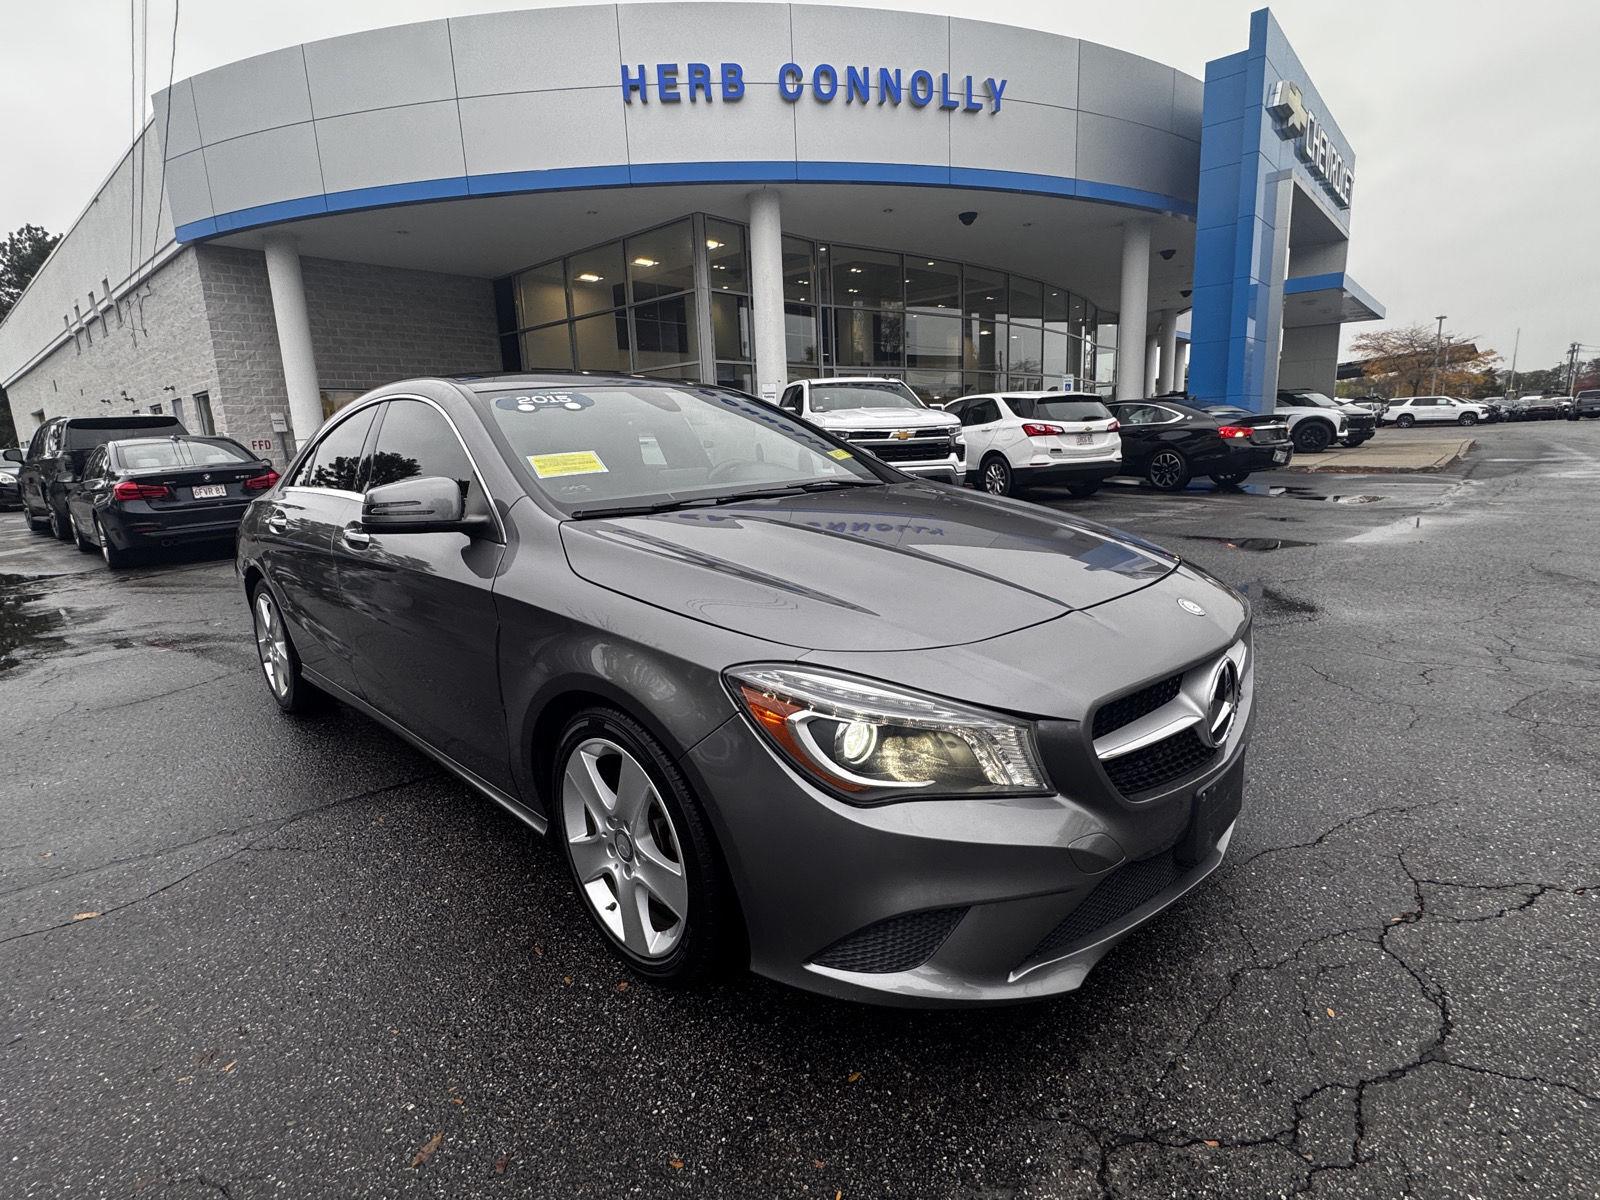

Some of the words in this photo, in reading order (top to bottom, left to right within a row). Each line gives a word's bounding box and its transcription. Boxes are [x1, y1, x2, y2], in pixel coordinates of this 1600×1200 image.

[621, 63, 746, 103] HERB
[778, 63, 1008, 115] CONNOLLY
[516, 395, 572, 405] 2015
[251, 440, 271, 450] FFD
